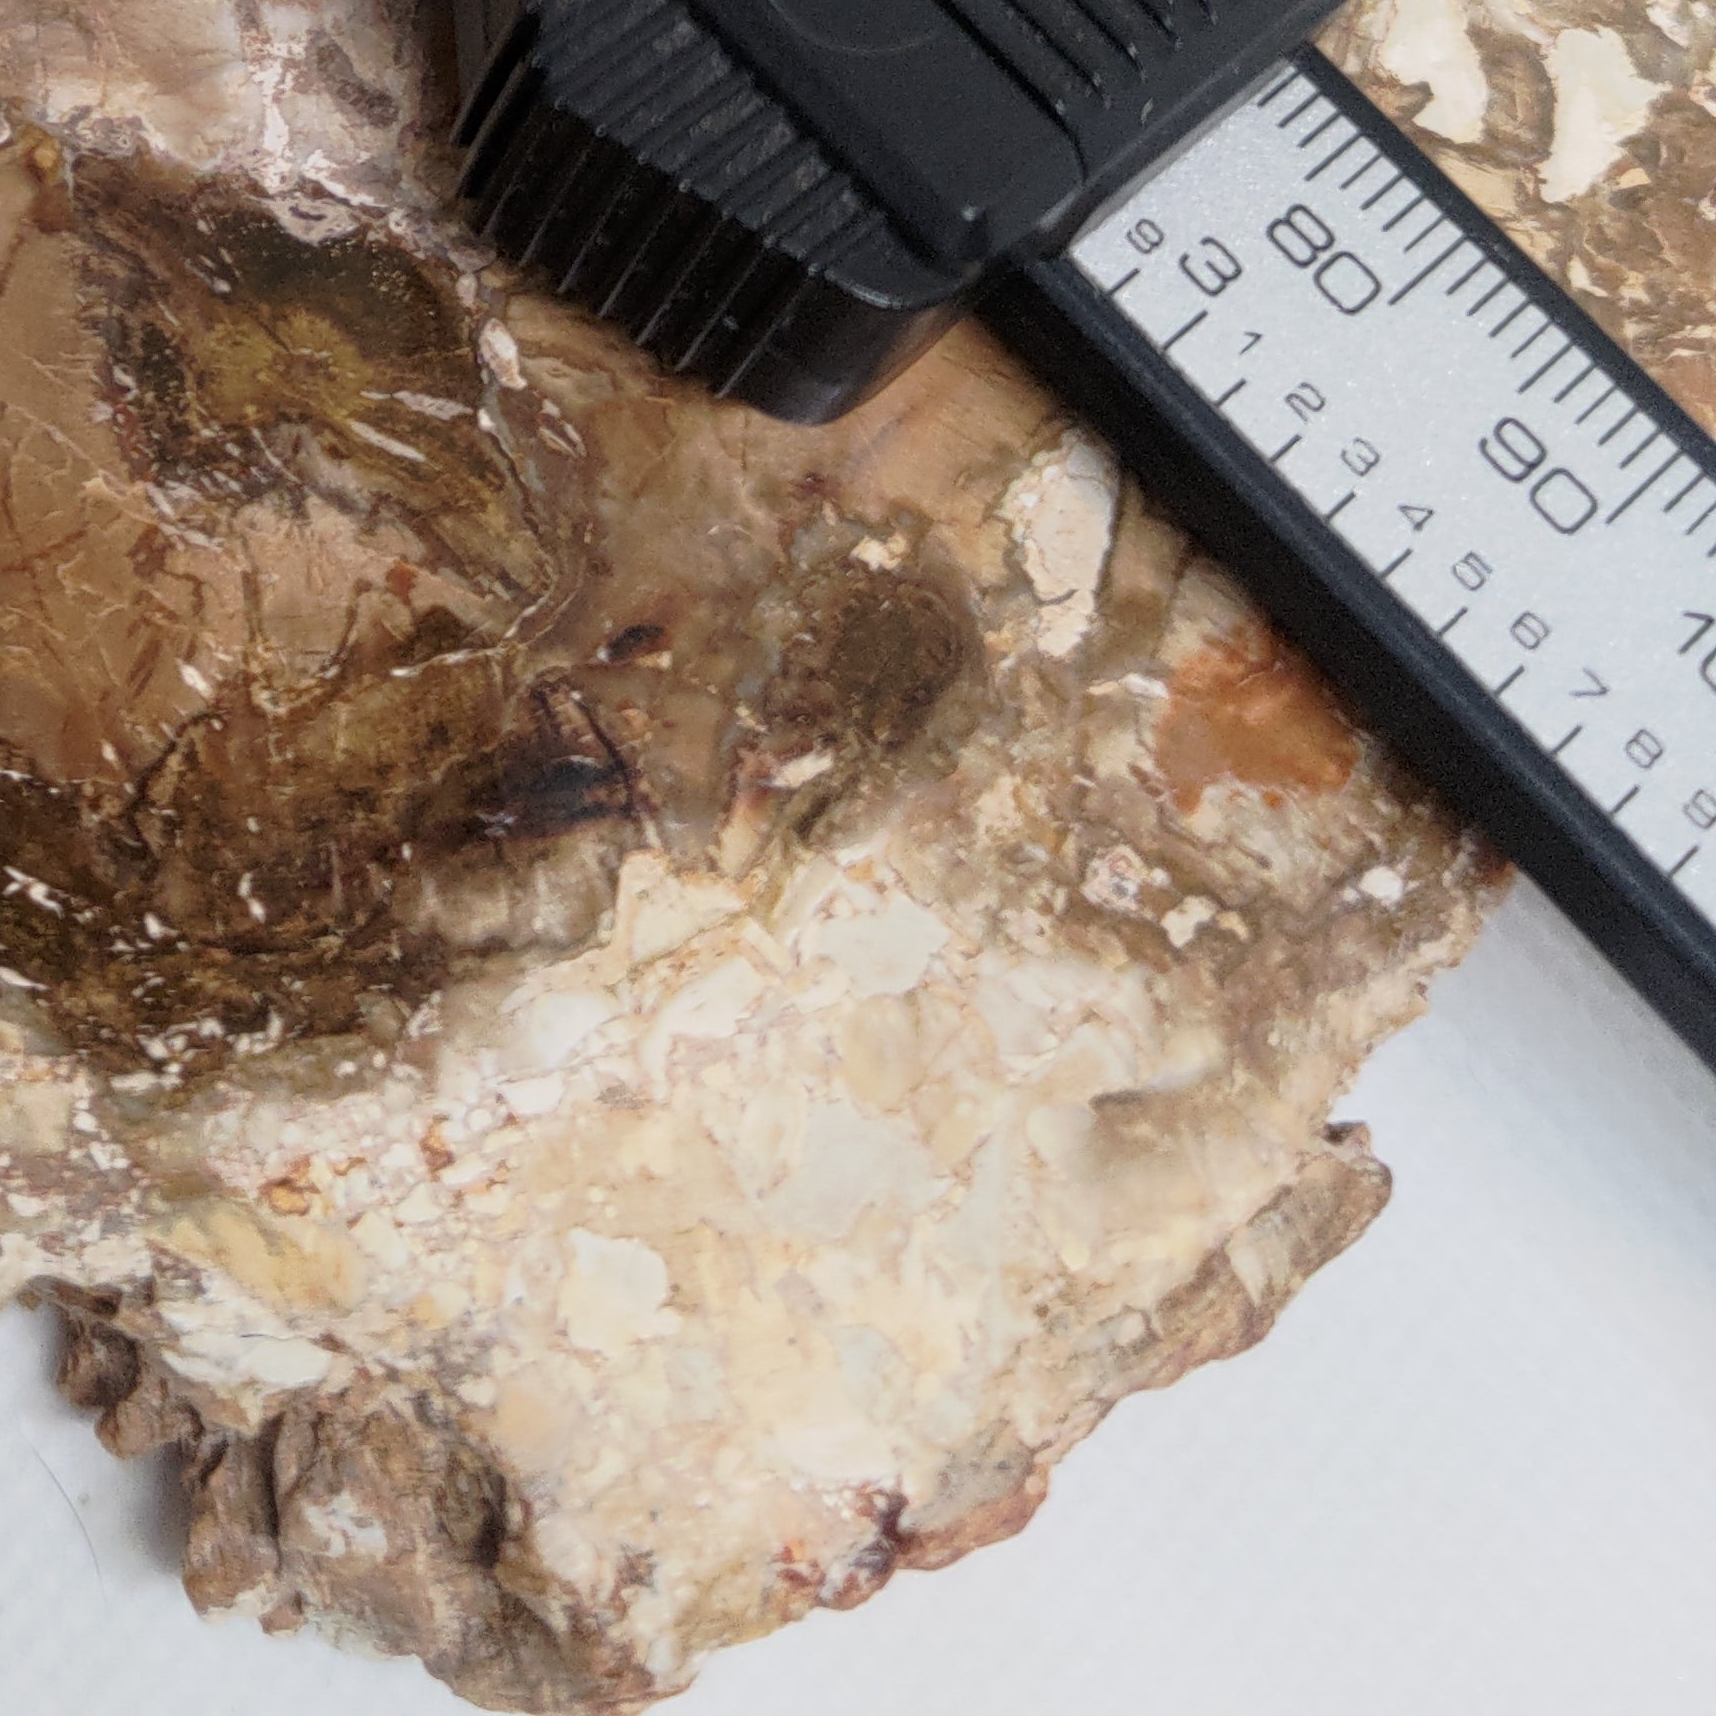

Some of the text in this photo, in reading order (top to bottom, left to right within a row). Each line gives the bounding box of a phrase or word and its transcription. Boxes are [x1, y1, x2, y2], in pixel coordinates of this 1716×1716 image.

[1125, 218, 1164, 255] 9
[1239, 330, 1263, 354] 1
[1284, 382, 1326, 421] 2
[1340, 438, 1380, 477] 3
[1398, 503, 1435, 531] 4
[1452, 551, 1493, 591] 5
[1510, 611, 1550, 650] 6
[1570, 667, 1610, 696] 7
[1625, 729, 1664, 769] 8
[1179, 237, 1242, 297] 3
[1266, 204, 1716, 694] 80 90 1
